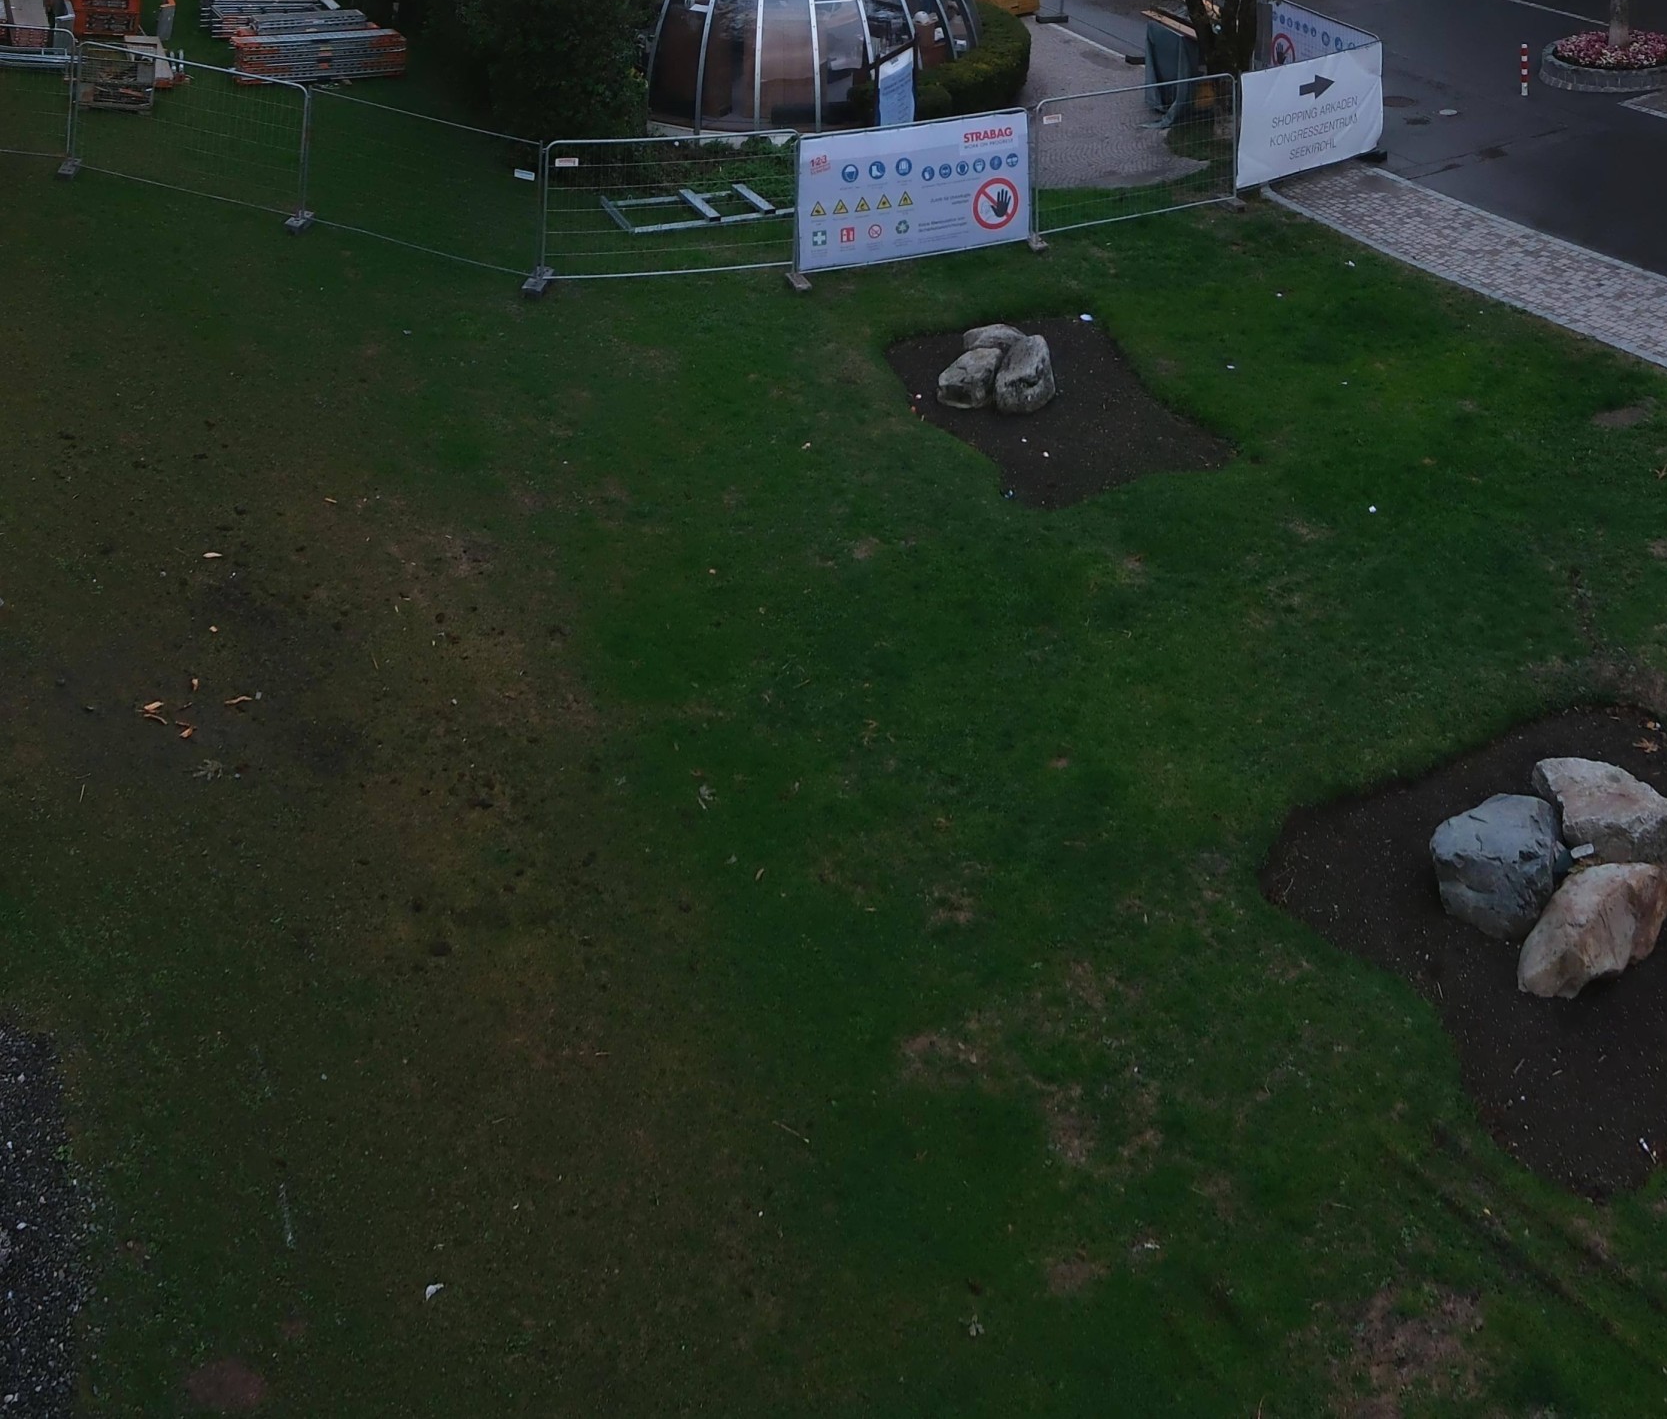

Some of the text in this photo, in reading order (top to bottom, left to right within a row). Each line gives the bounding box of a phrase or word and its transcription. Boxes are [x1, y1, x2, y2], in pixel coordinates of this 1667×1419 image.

[1271, 96, 1358, 129] SHOPPING ARKADEN
[963, 127, 1013, 143] STRABAG
[1269, 112, 1358, 147] KONGRESSZENTRUM
[1288, 137, 1337, 161] SEEKIRCHL
